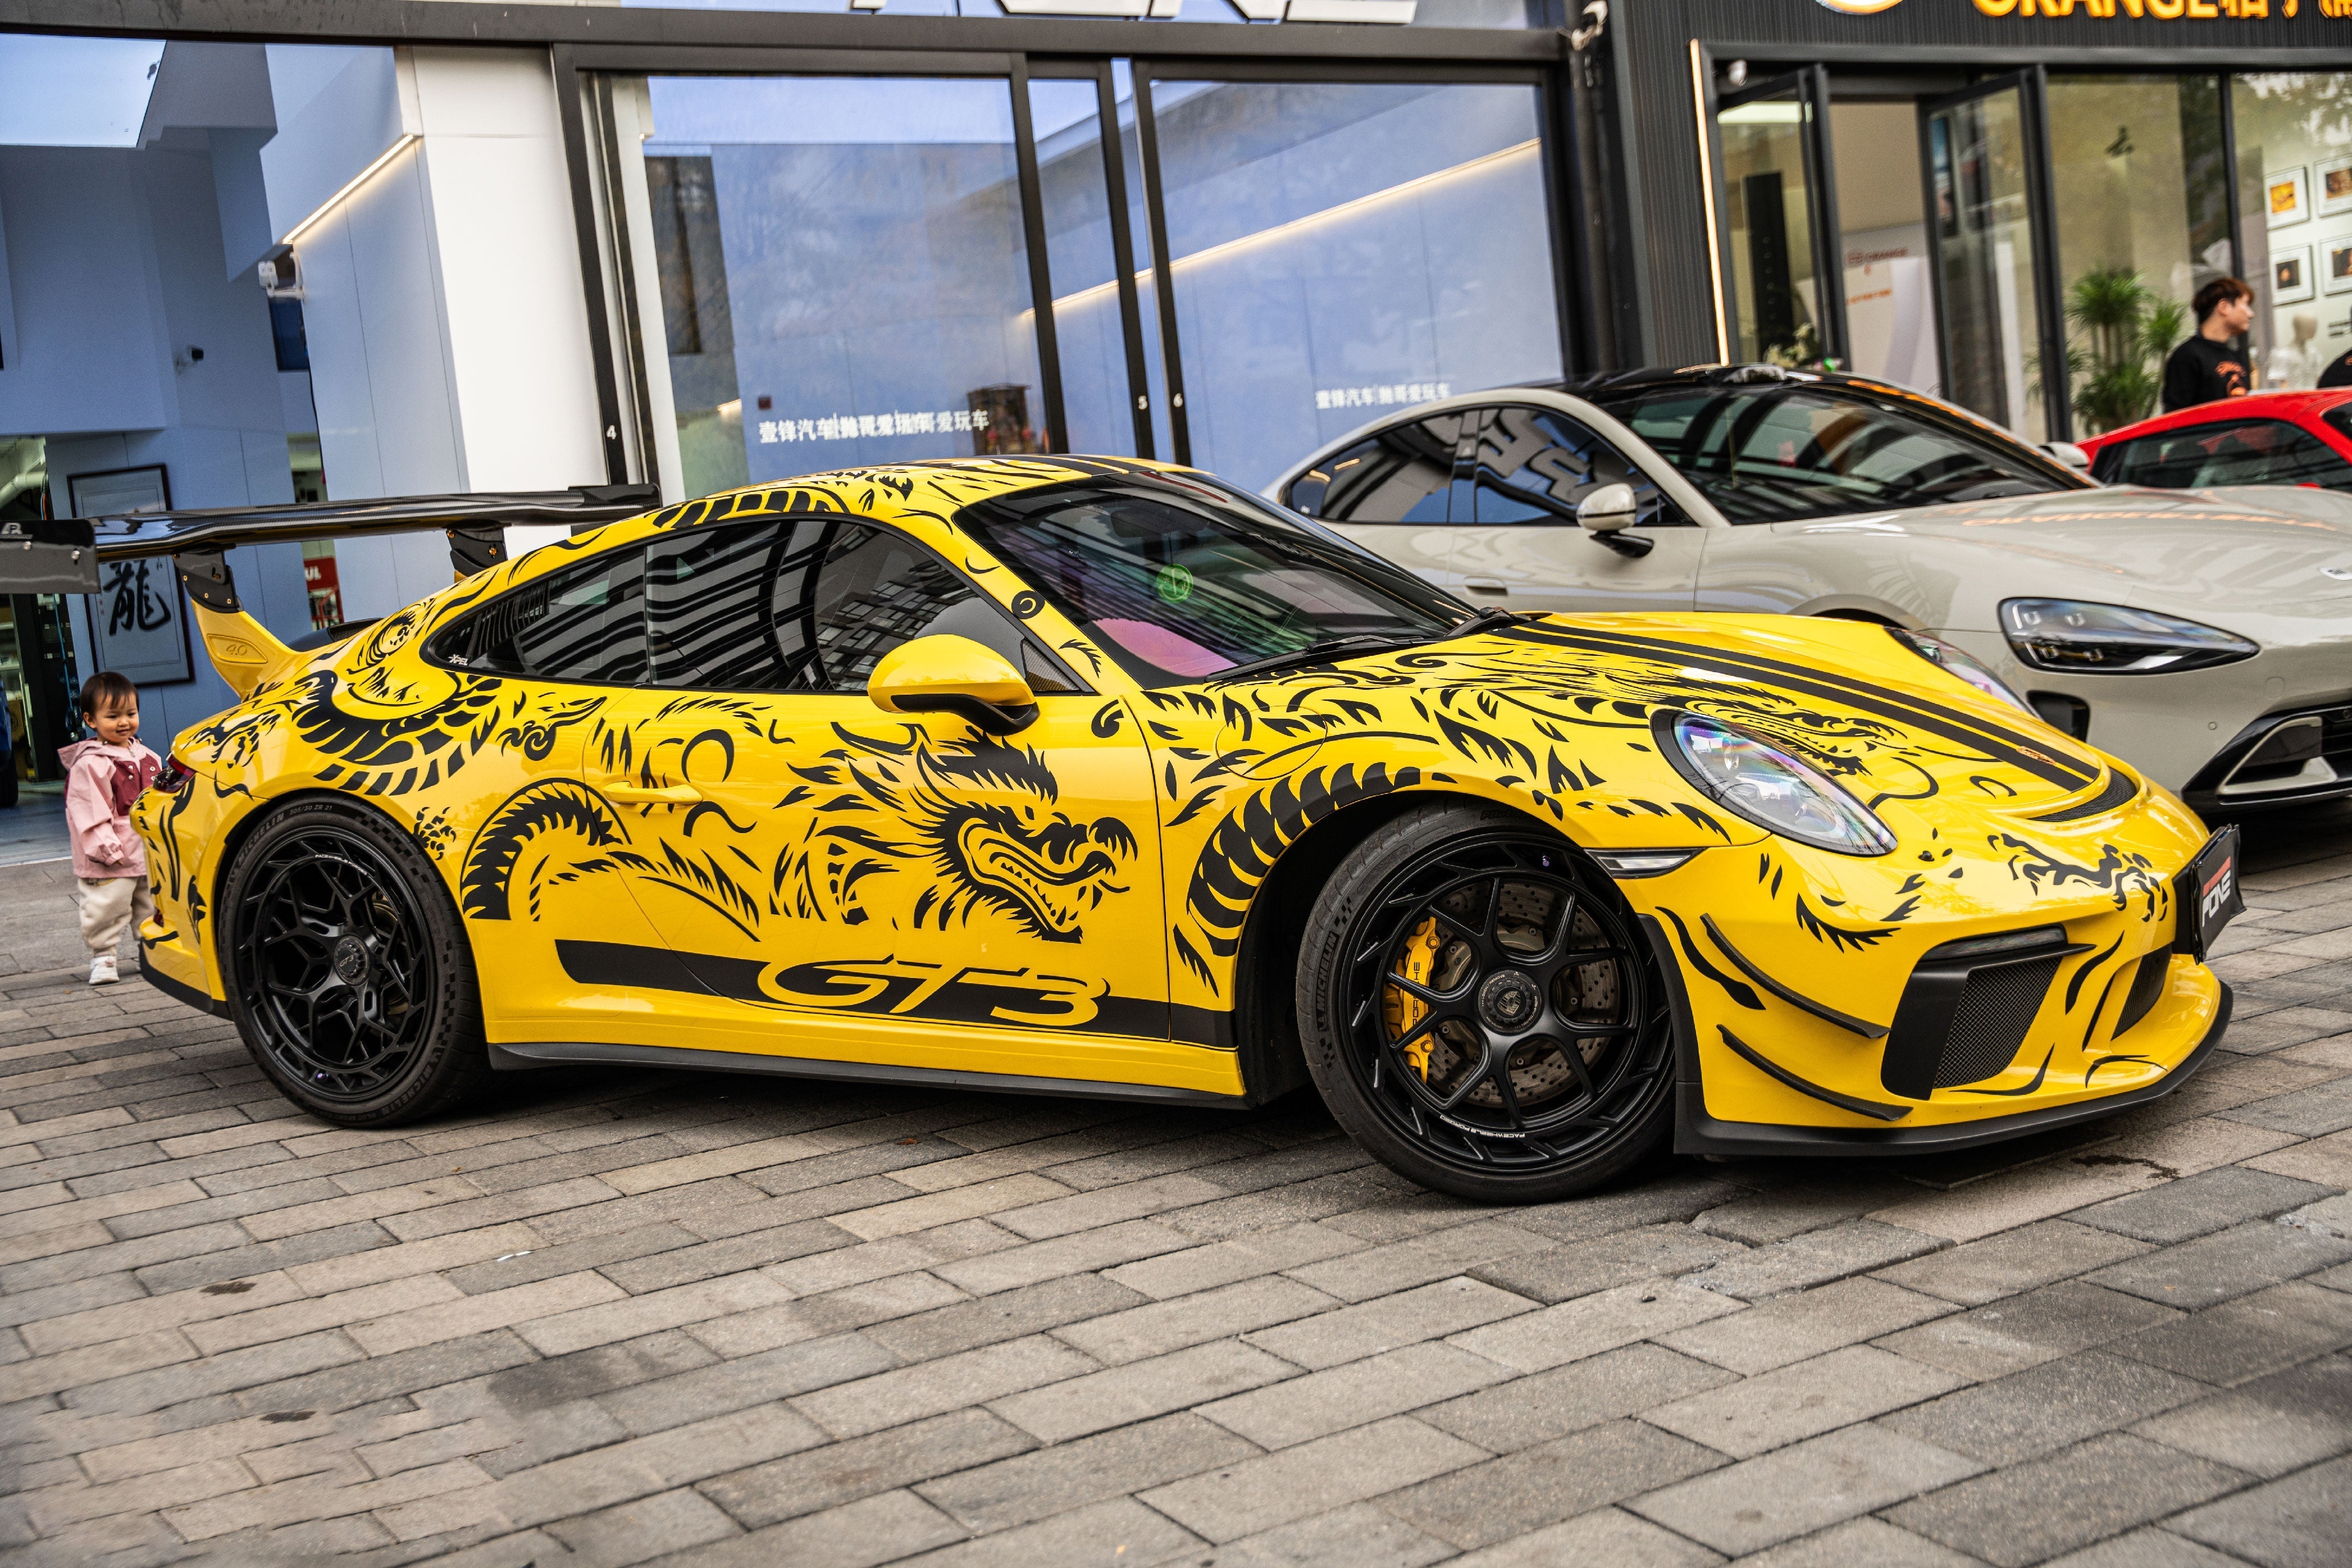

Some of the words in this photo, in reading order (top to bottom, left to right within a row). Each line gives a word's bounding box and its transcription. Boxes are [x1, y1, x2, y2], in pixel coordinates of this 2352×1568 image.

[1138, 396, 1147, 410] 5
[1173, 393, 1183, 407] 6
[606, 425, 617, 440] 4
[226, 644, 248, 656] 4.0
[449, 654, 468, 666] XPEL
[238, 812, 285, 866] MICHELIN
[1317, 932, 1337, 1012] MICHELIN
[757, 954, 1110, 1027] GT3
